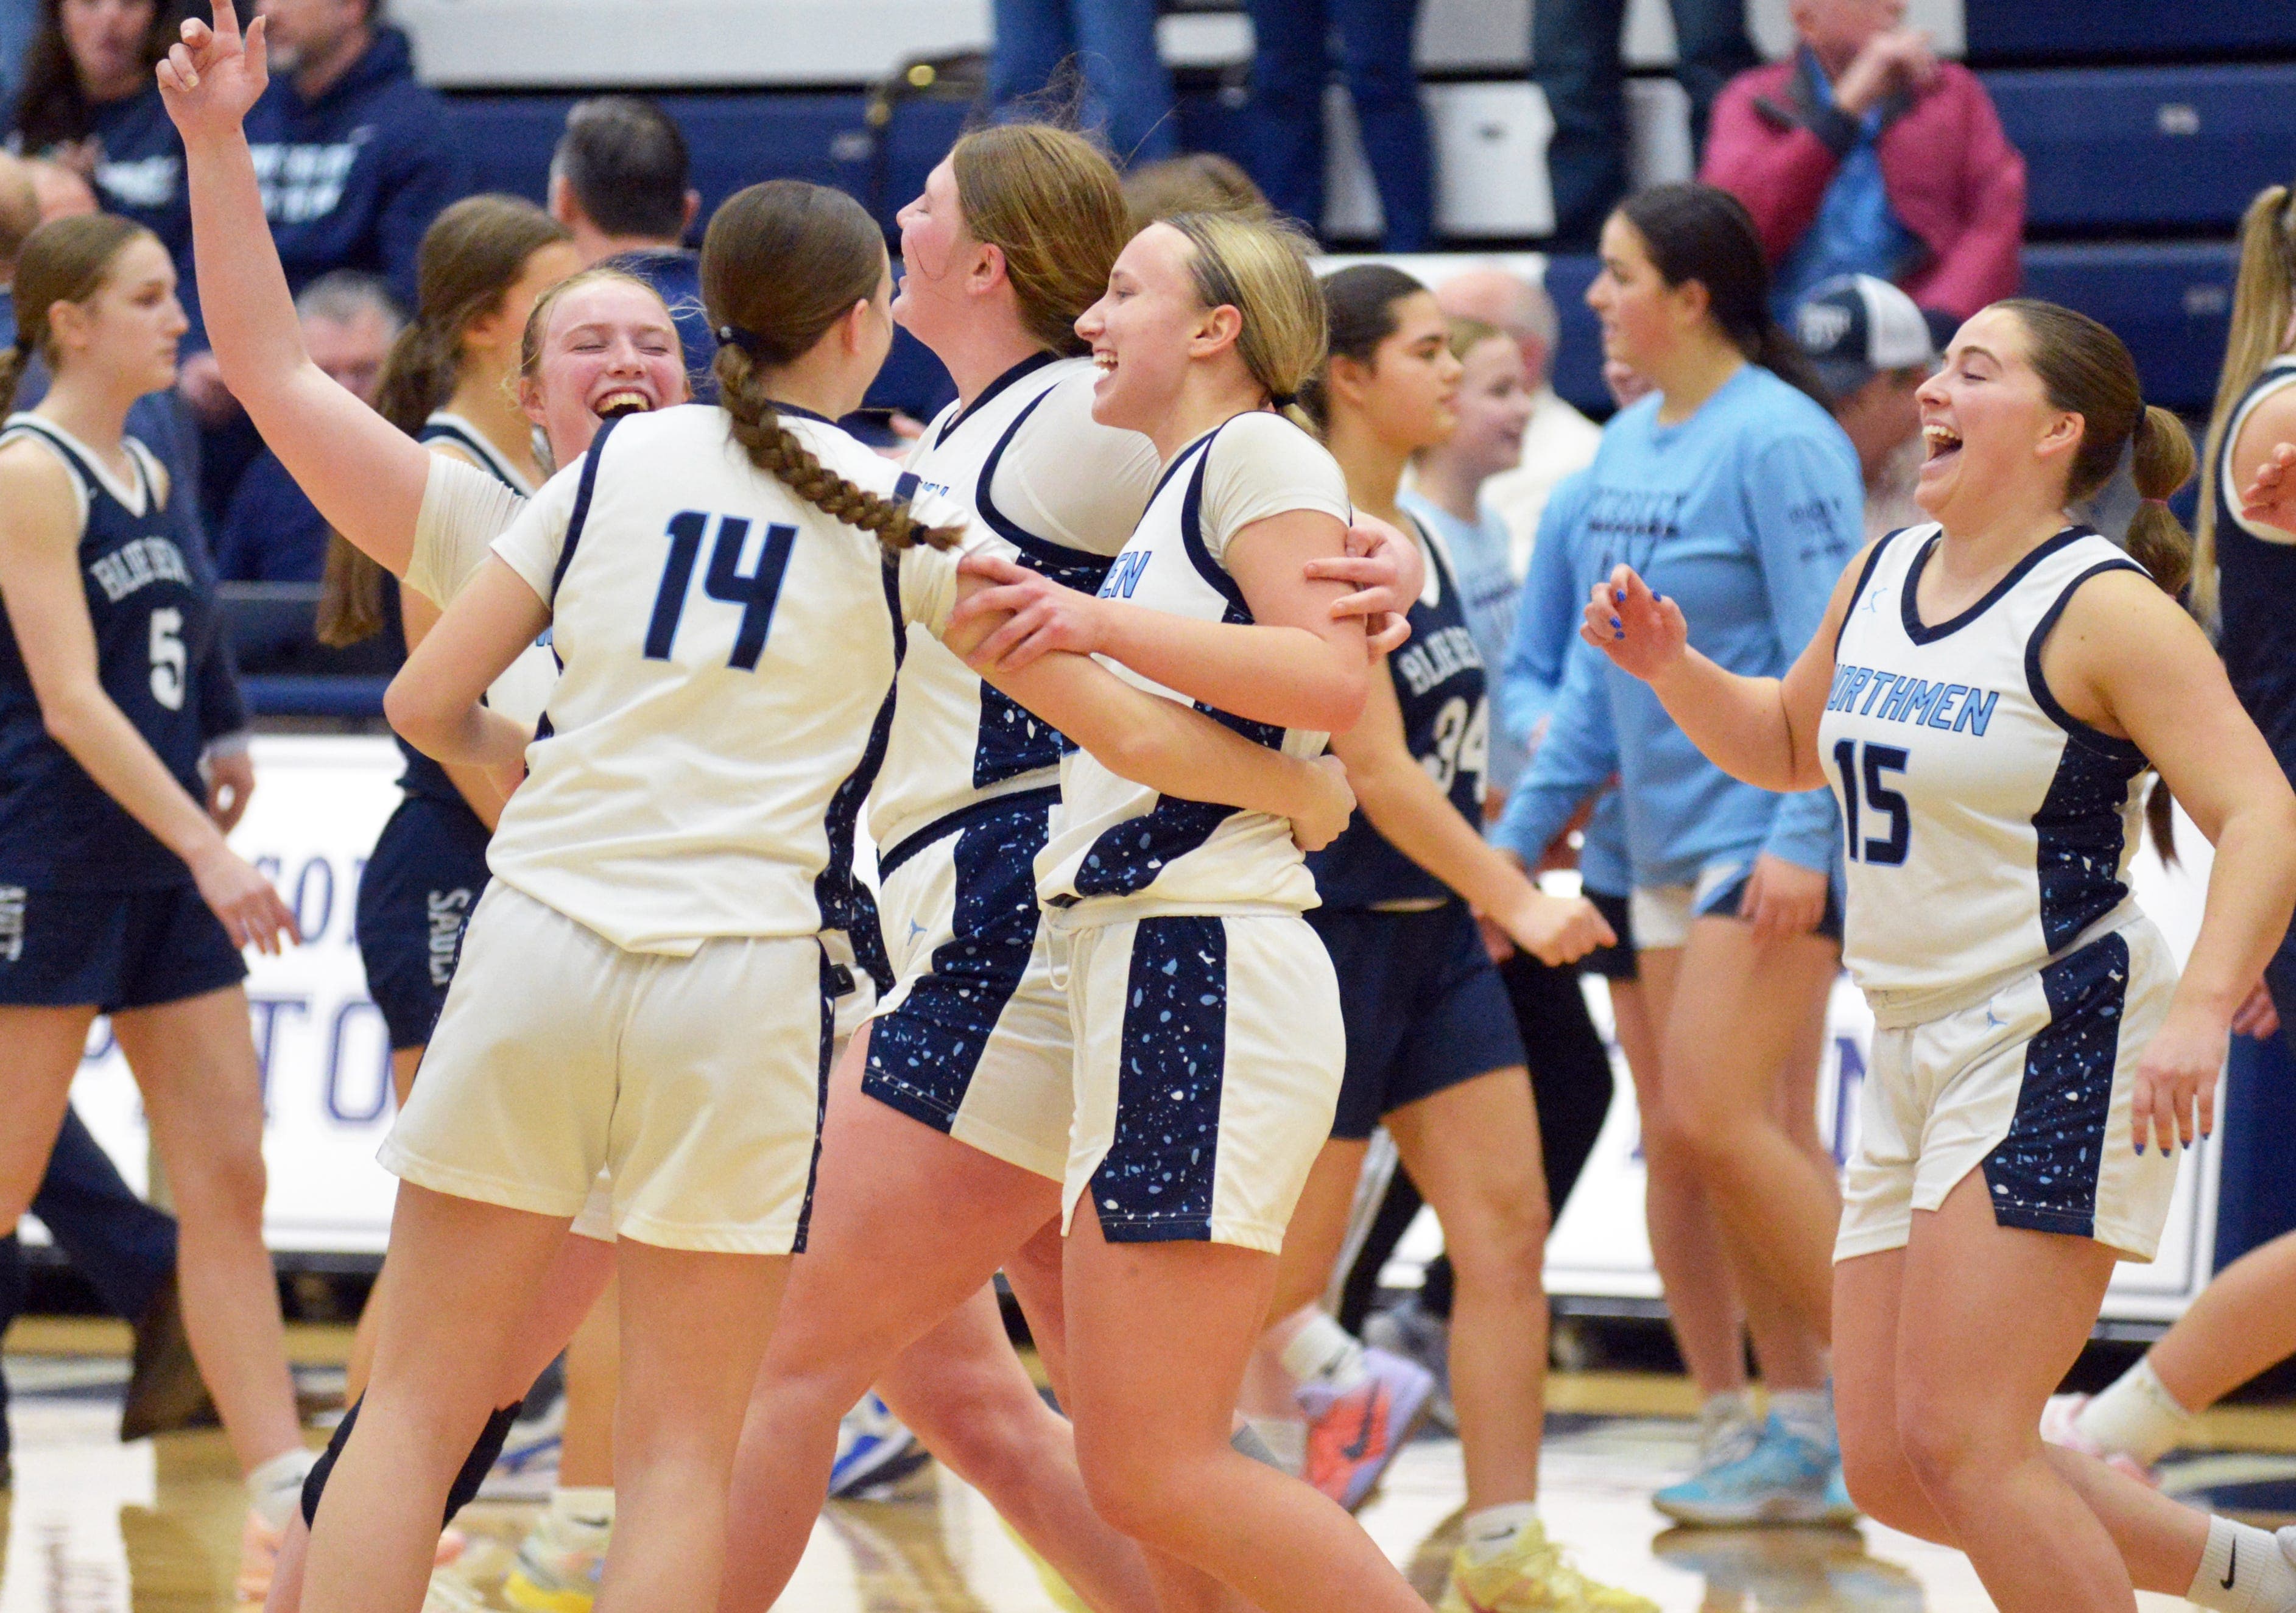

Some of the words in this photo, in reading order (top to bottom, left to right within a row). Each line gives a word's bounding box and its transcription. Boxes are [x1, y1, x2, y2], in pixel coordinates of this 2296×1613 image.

[643, 508, 800, 673] 14
[150, 607, 186, 709] 5
[1422, 696, 1490, 805] 34
[1833, 737, 1912, 868] 15
